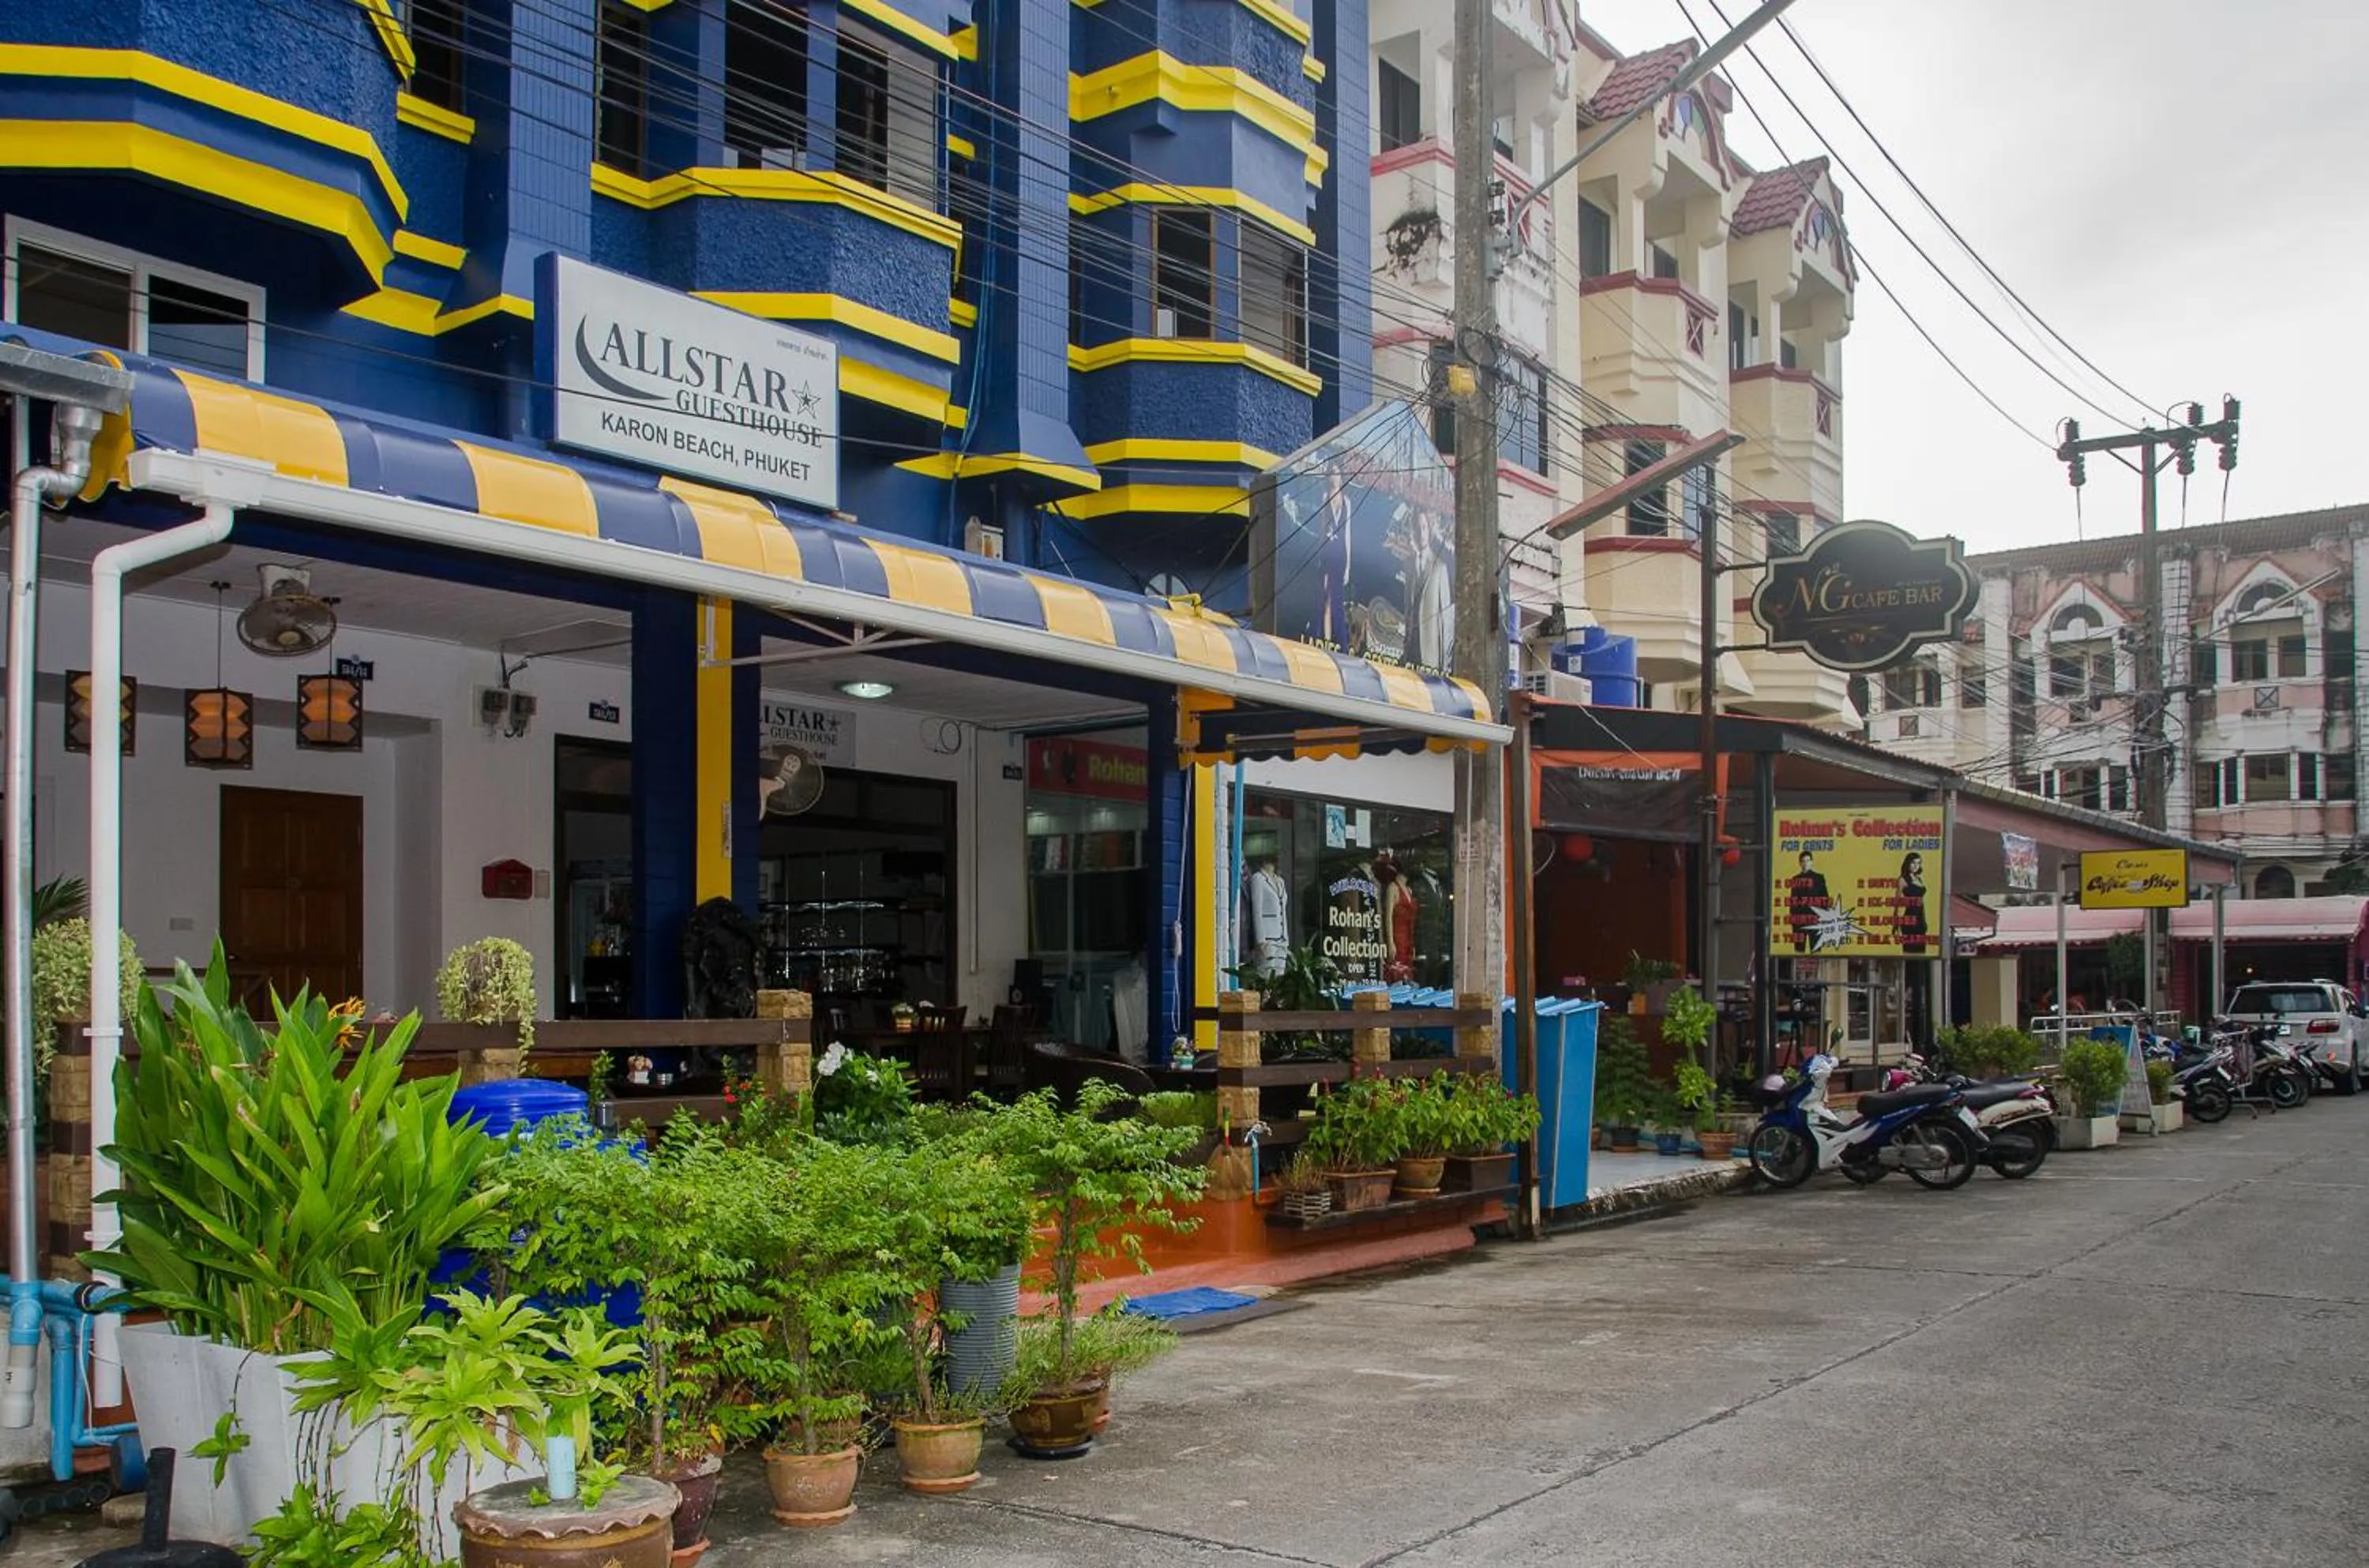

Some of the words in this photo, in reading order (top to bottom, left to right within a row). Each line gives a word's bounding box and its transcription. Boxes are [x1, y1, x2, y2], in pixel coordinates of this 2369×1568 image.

[601, 322, 790, 413] ALLSTAR
[677, 388, 822, 448] GUESTHOUSE
[602, 411, 668, 445] KARON
[674, 430, 738, 467] BEACH,
[745, 449, 811, 481] PHUKET
[1852, 592, 1900, 609] CAFE
[1905, 587, 1943, 605] BAR
[770, 726, 838, 746] GUESTHOUSE
[1779, 819, 1846, 838] Rohan's
[1852, 817, 1941, 838] Collection
[1781, 840, 1800, 852] FOR
[1803, 840, 1834, 851] GENTS
[1883, 839, 1903, 851] FOR
[1905, 838, 1939, 850] LADIES
[2142, 872, 2180, 892] Shop
[1329, 906, 1381, 929] Rohan's
[1323, 936, 1387, 958] Collection
[1348, 962, 1365, 973] OPEN
